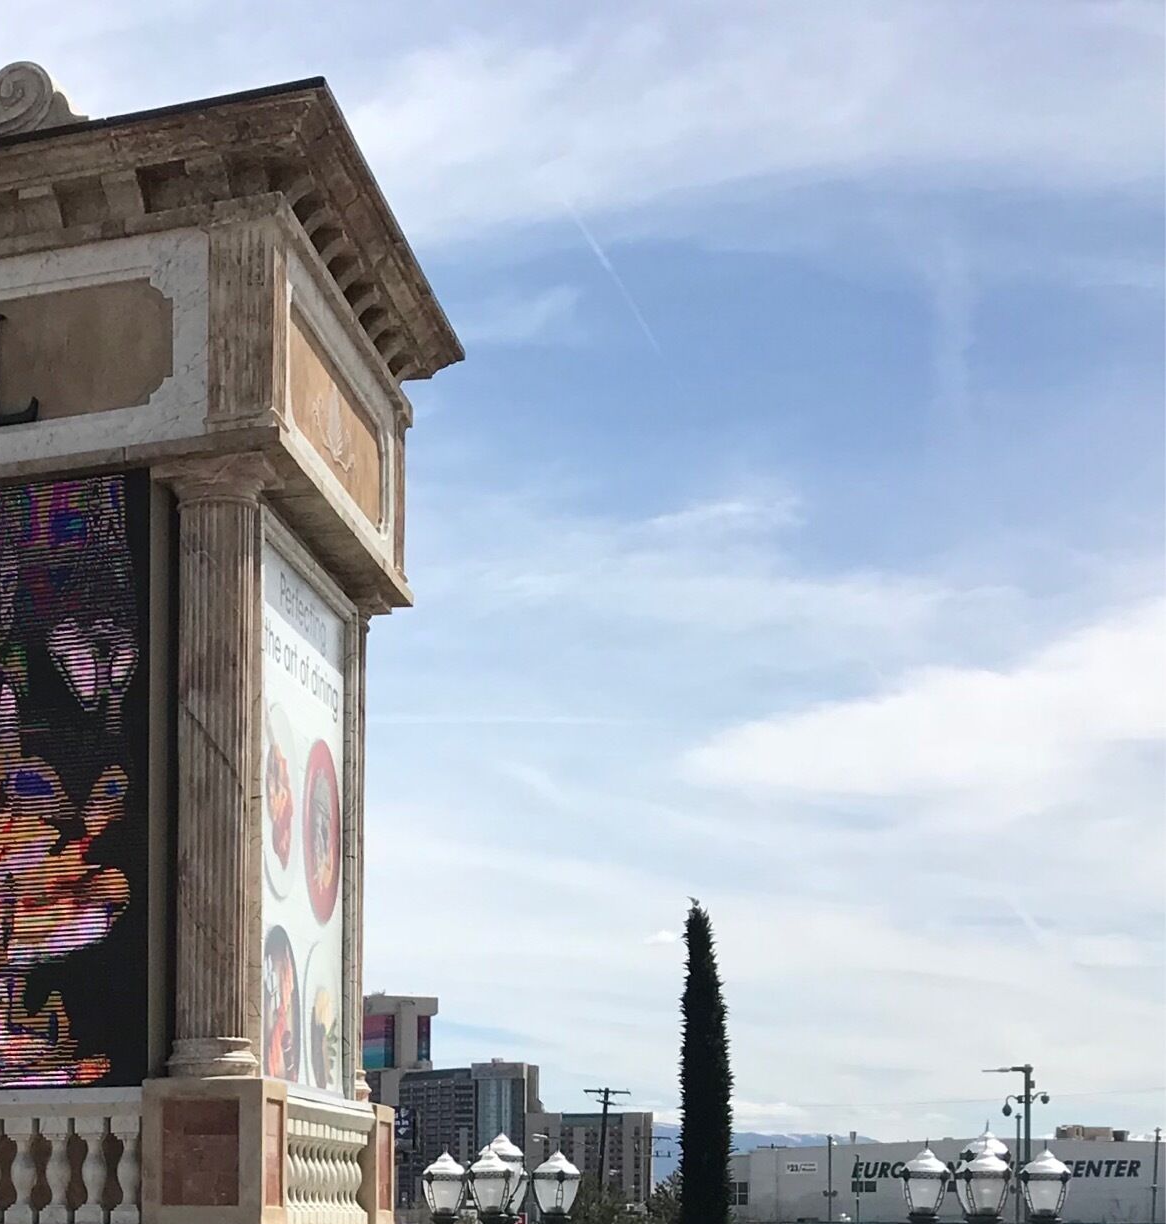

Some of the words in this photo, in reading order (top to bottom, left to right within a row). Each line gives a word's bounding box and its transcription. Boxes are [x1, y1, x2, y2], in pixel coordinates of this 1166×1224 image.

[280, 571, 327, 657] Perfecting
[265, 617, 281, 663] the
[284, 643, 298, 679] art
[300, 655, 310, 689] of
[311, 663, 339, 723] dining
